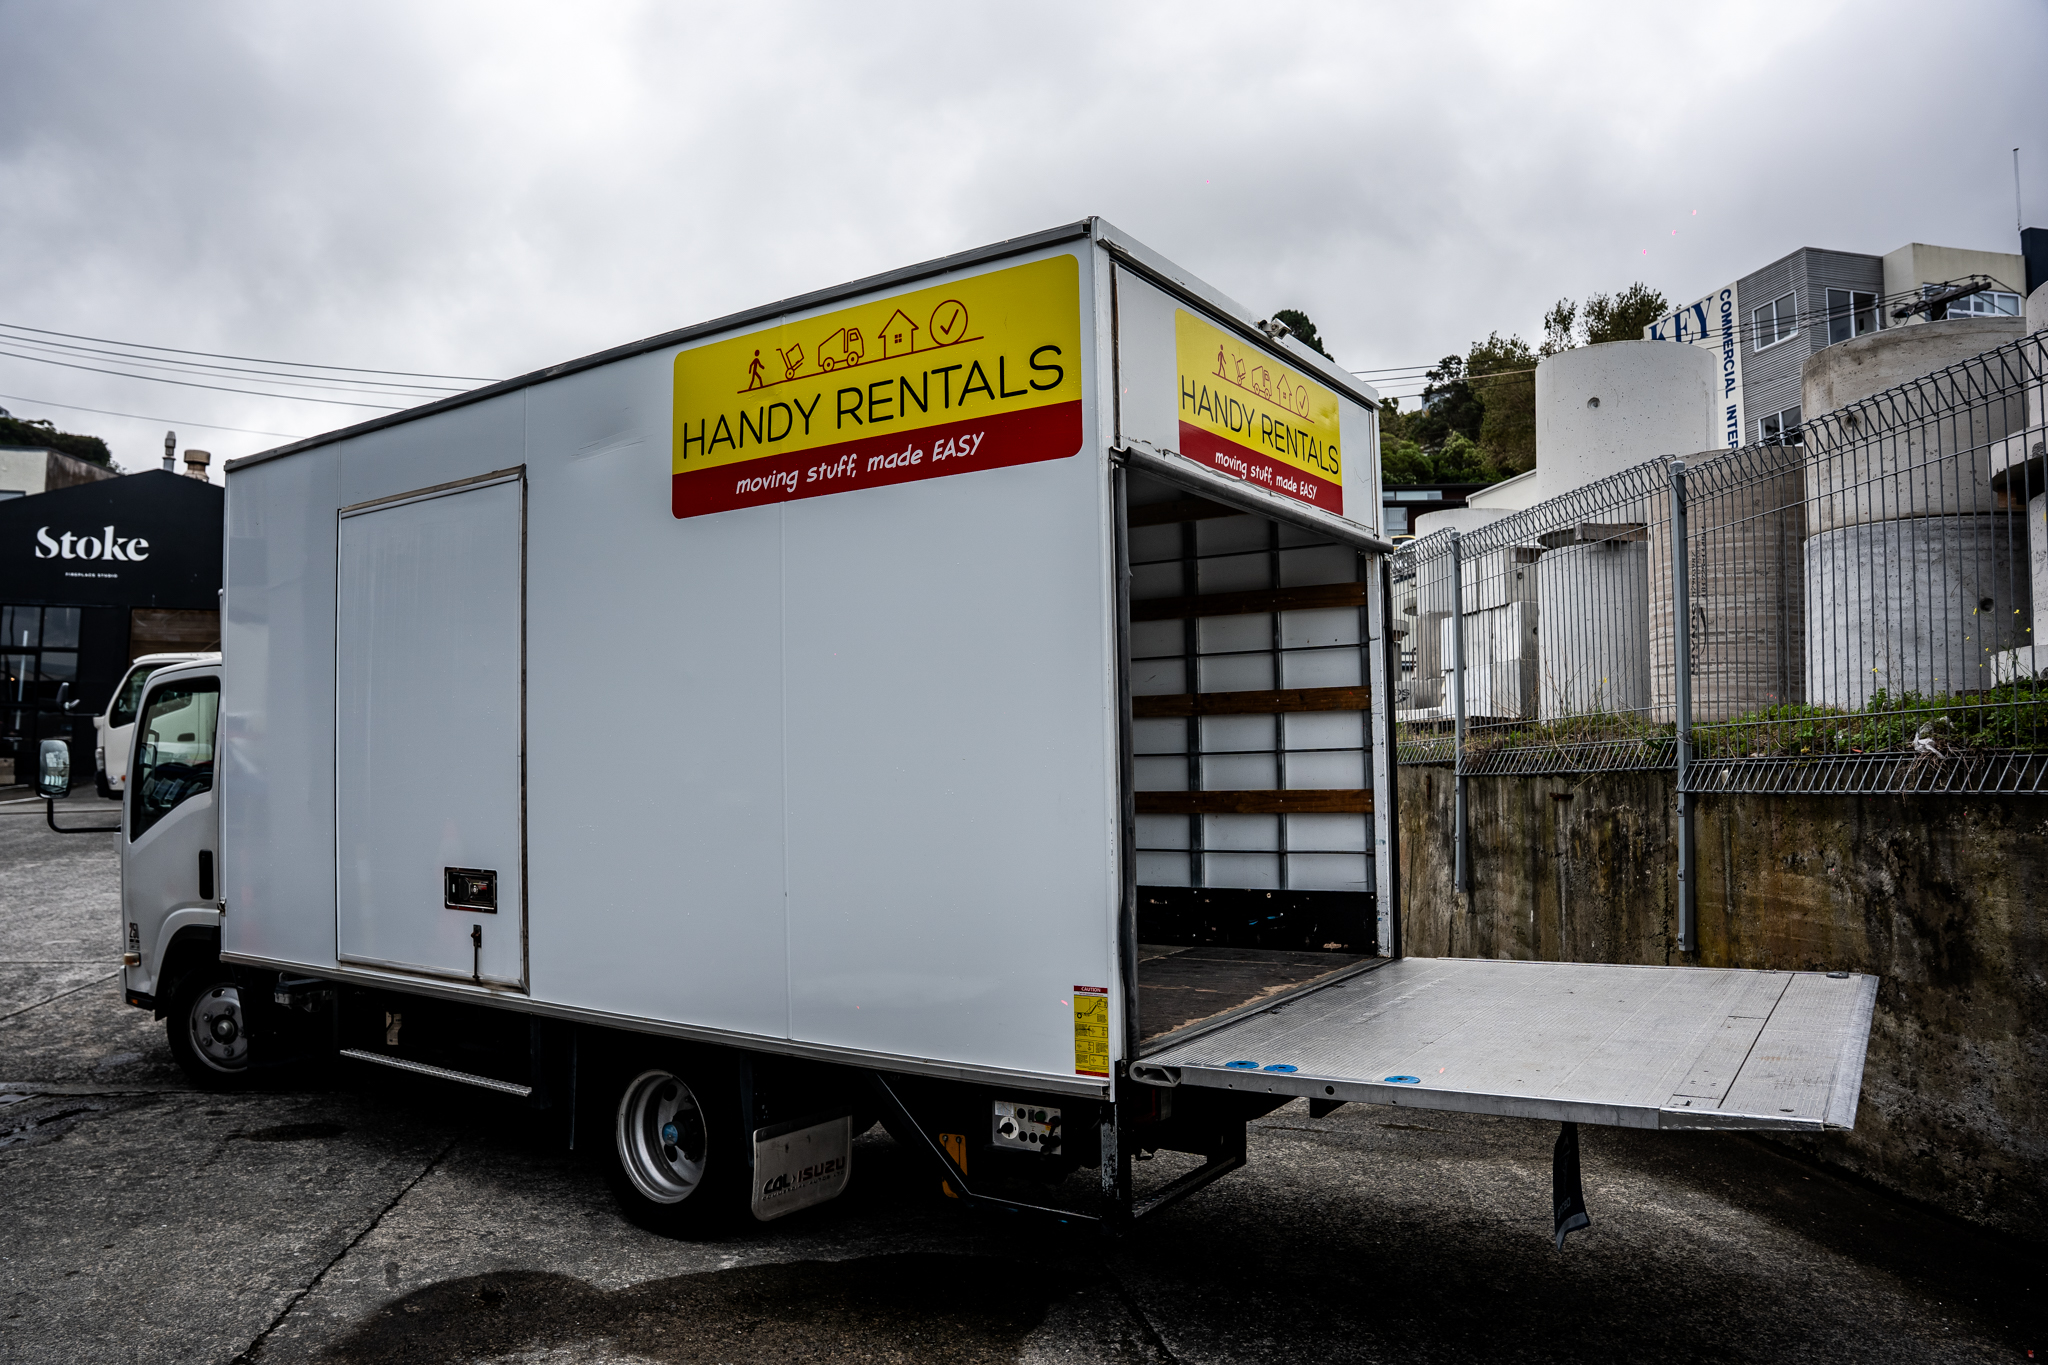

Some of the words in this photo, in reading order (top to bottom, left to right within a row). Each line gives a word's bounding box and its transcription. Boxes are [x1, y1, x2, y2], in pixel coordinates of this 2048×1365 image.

[1649, 296, 1714, 344] KEY
[1720, 288, 1736, 399] COMMERCIAL
[683, 393, 822, 460] HANDY
[836, 344, 1065, 430] RENTALS
[1181, 374, 1255, 438] HANDY
[1261, 413, 1339, 475] RENTALS
[735, 469, 799, 494] moving
[806, 453, 857, 483] stuff,
[867, 444, 924, 473] made
[932, 431, 985, 460] EASY
[1215, 451, 1247, 479] moving
[1250, 464, 1273, 487] stuff,
[1275, 474, 1298, 494] made
[1299, 481, 1318, 500] EASY
[35, 525, 150, 562] Stoke
[797, 1156, 846, 1183] ISUZU
